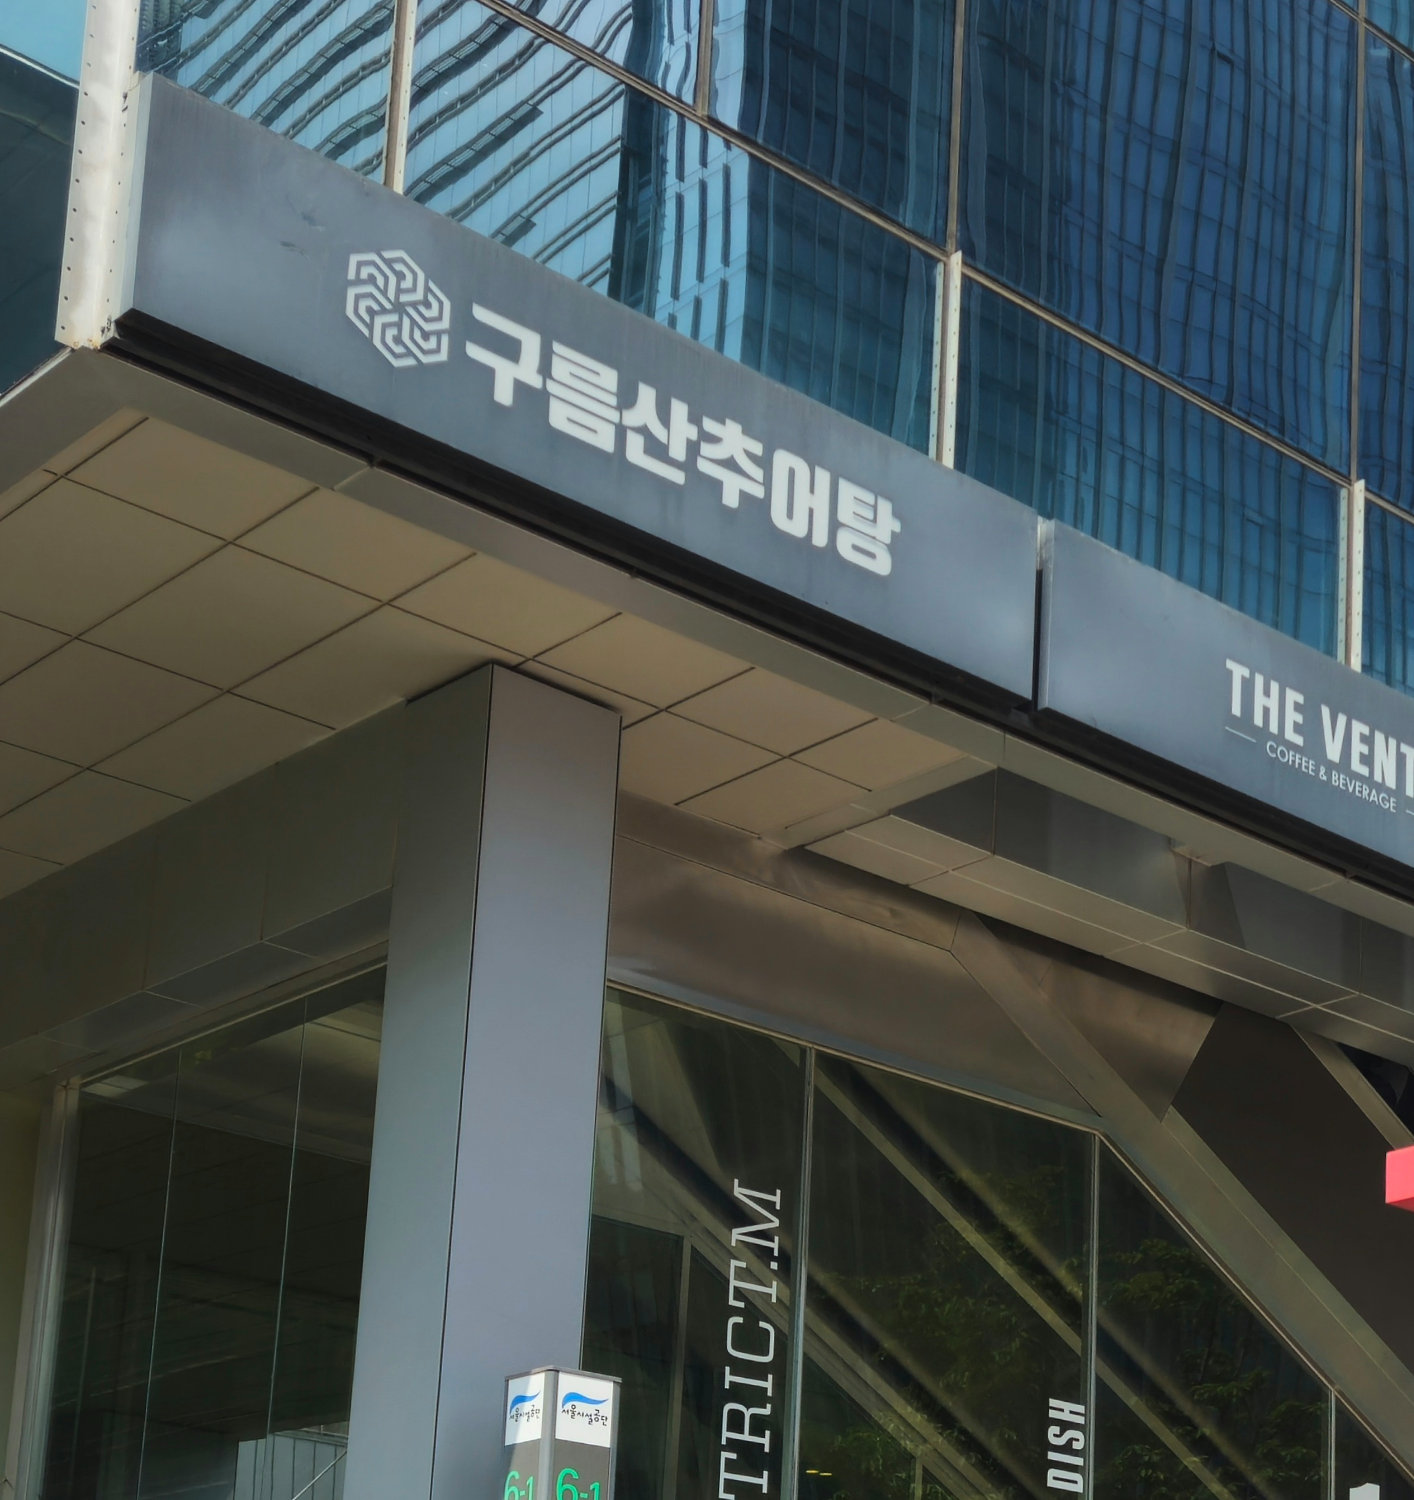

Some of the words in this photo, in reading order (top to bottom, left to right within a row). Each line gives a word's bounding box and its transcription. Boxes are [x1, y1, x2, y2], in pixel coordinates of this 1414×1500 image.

[465, 303, 901, 577] 구름산추어탕
[1226, 658, 1304, 747] THE
[1266, 740, 1316, 776] COFFEE
[1319, 765, 1328, 782] &
[1331, 770, 1397, 813] BEVERAGE
[561, 1403, 608, 1426] 서울시설공단
[1047, 1397, 1086, 1494] DISH
